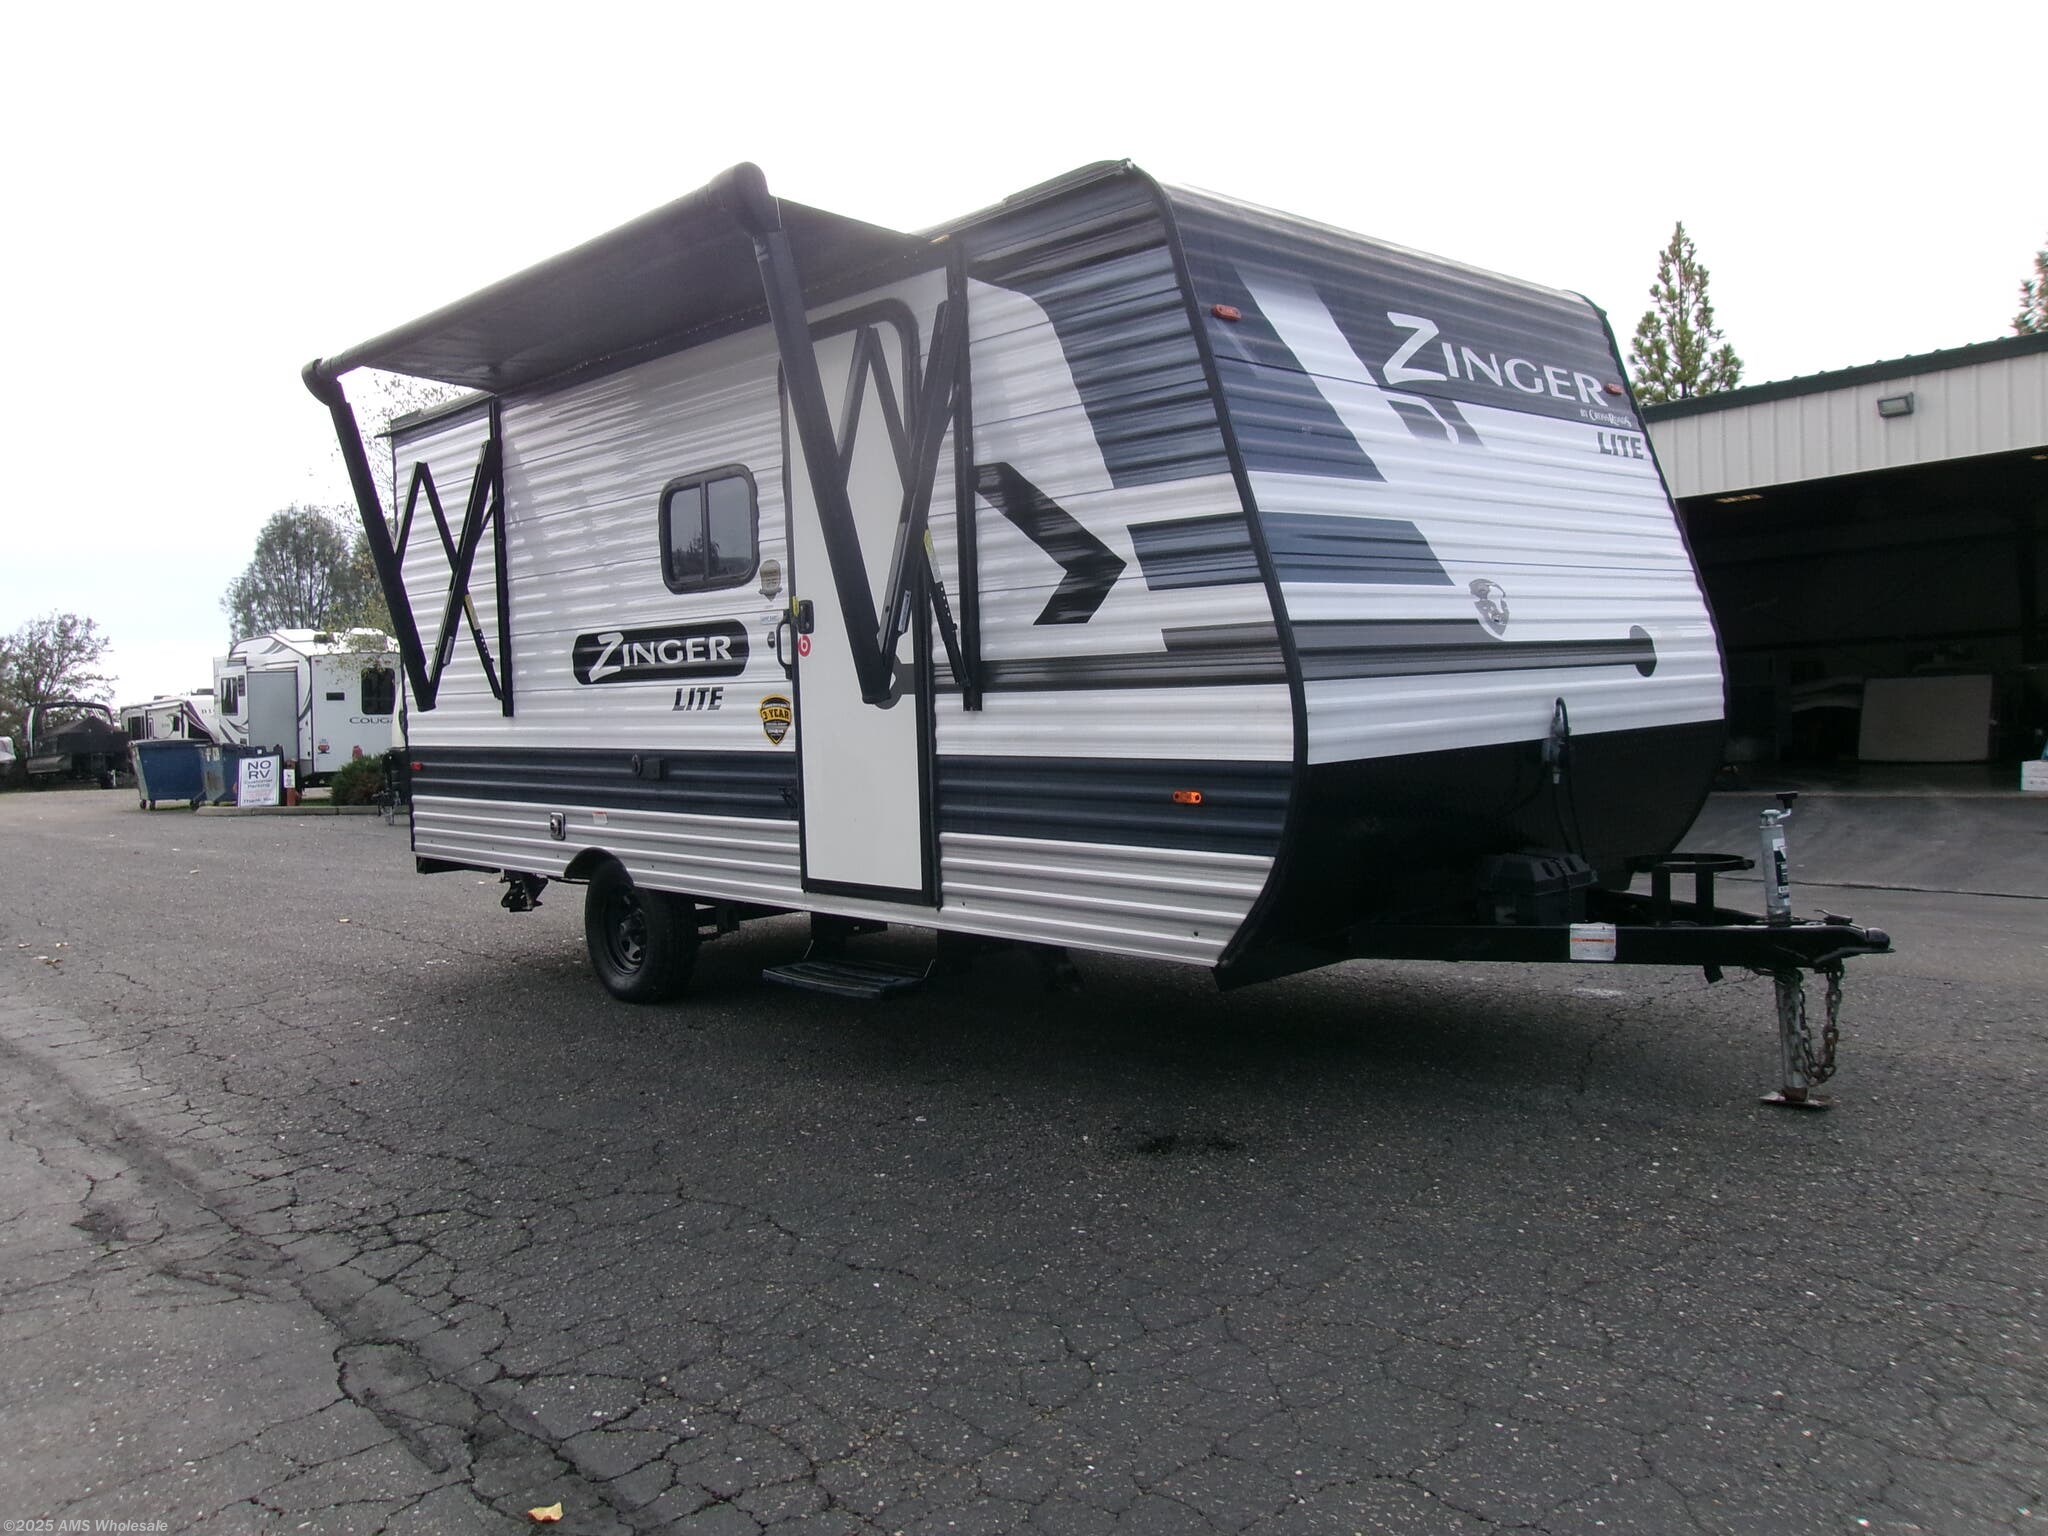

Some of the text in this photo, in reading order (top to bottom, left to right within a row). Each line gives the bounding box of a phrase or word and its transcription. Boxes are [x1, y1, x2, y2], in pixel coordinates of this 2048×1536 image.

[1383, 311, 1608, 407] ZINGER
[1597, 432, 1644, 459] LITE
[588, 632, 732, 683] ZINGER
[672, 687, 724, 711] LITE
[769, 709, 790, 720] YEAR
[248, 760, 271, 770] NO
[249, 770, 270, 779] RV
